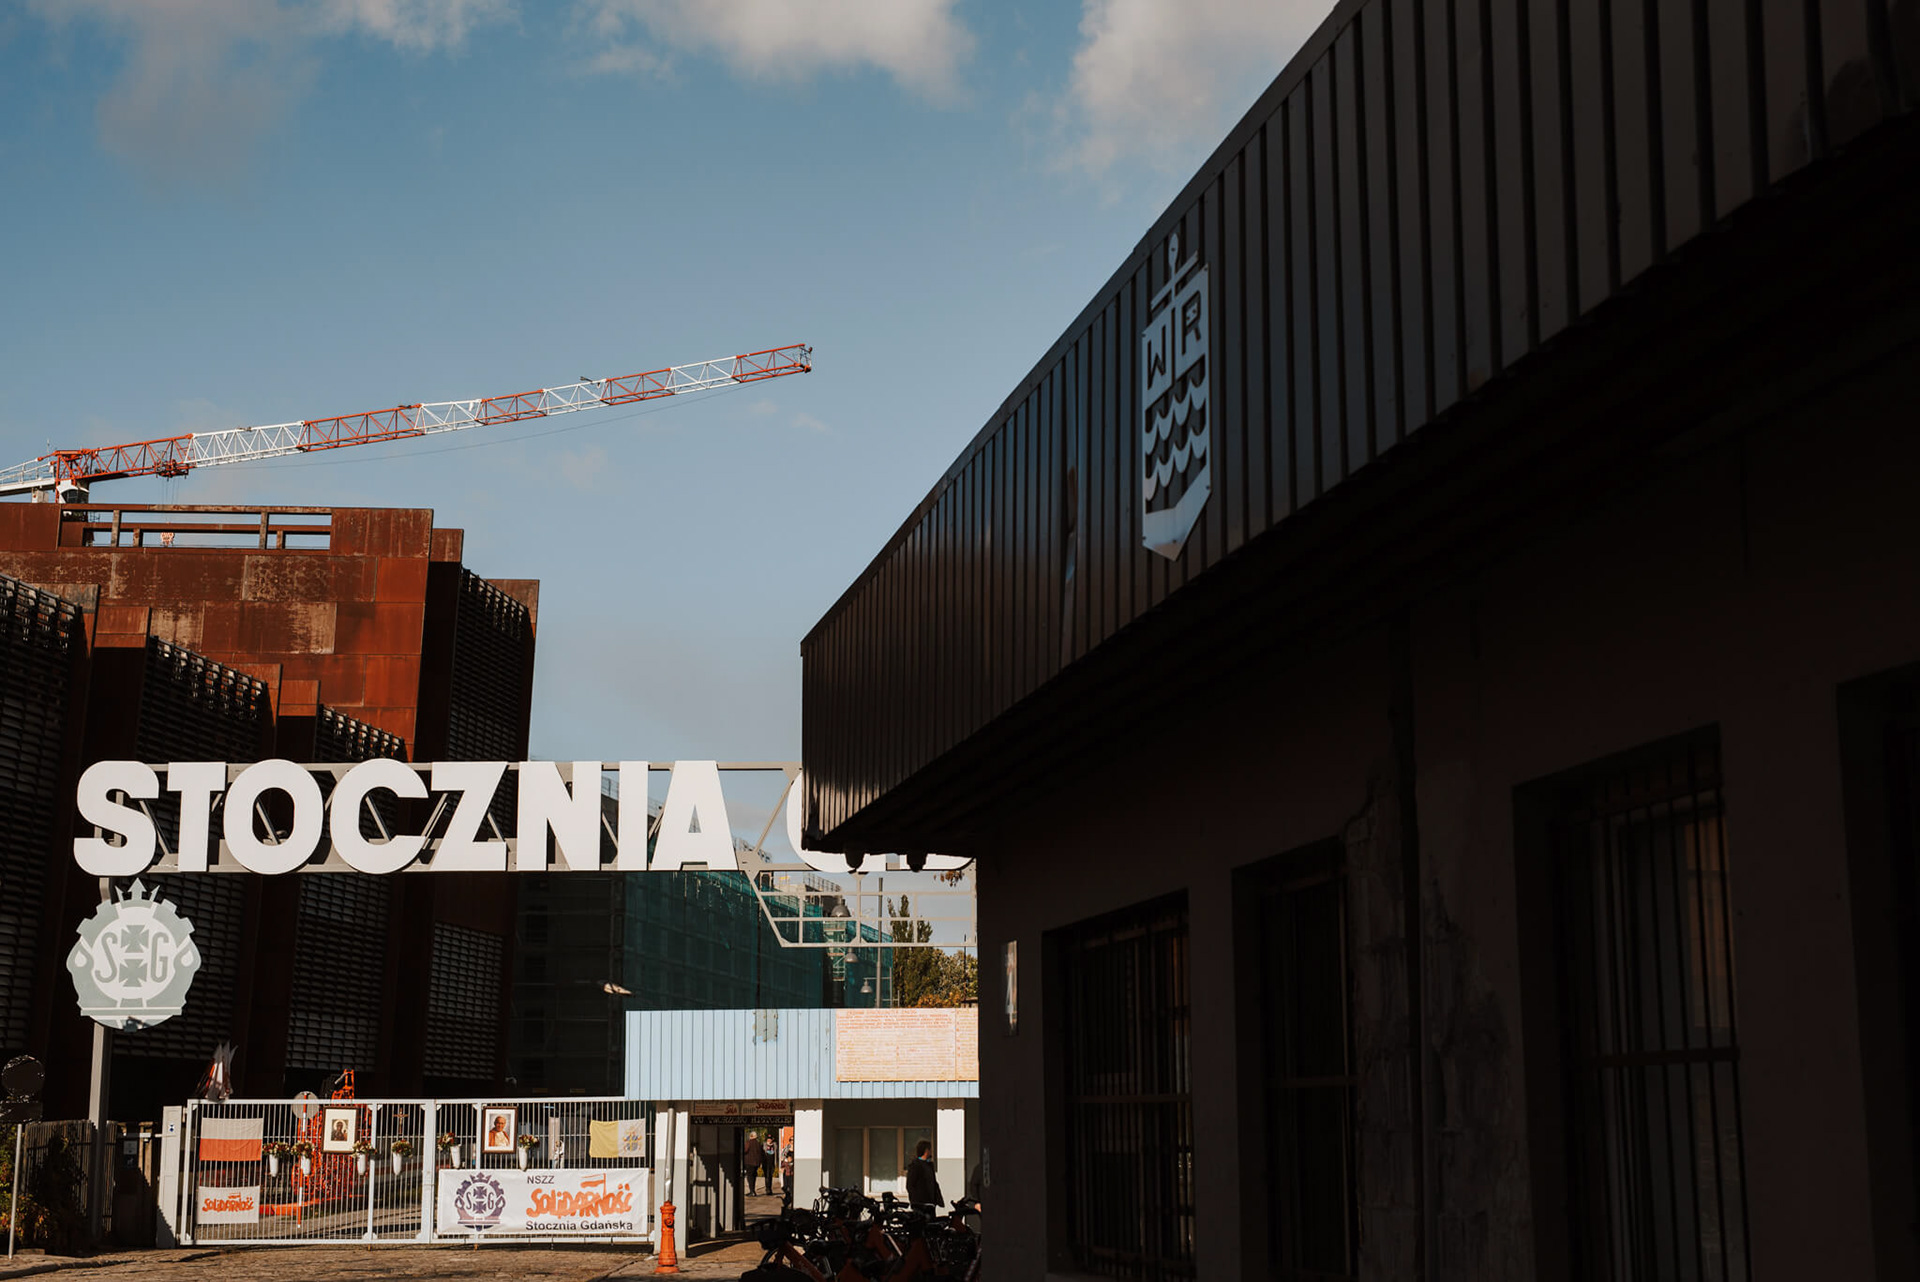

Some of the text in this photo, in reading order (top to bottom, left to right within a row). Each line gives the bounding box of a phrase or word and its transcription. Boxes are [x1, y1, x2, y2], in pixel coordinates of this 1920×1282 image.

[75, 758, 738, 875] STOCZNIA
[527, 1175, 555, 1185] NSZZ
[526, 1220, 633, 1231] Stocznia Gdańska
